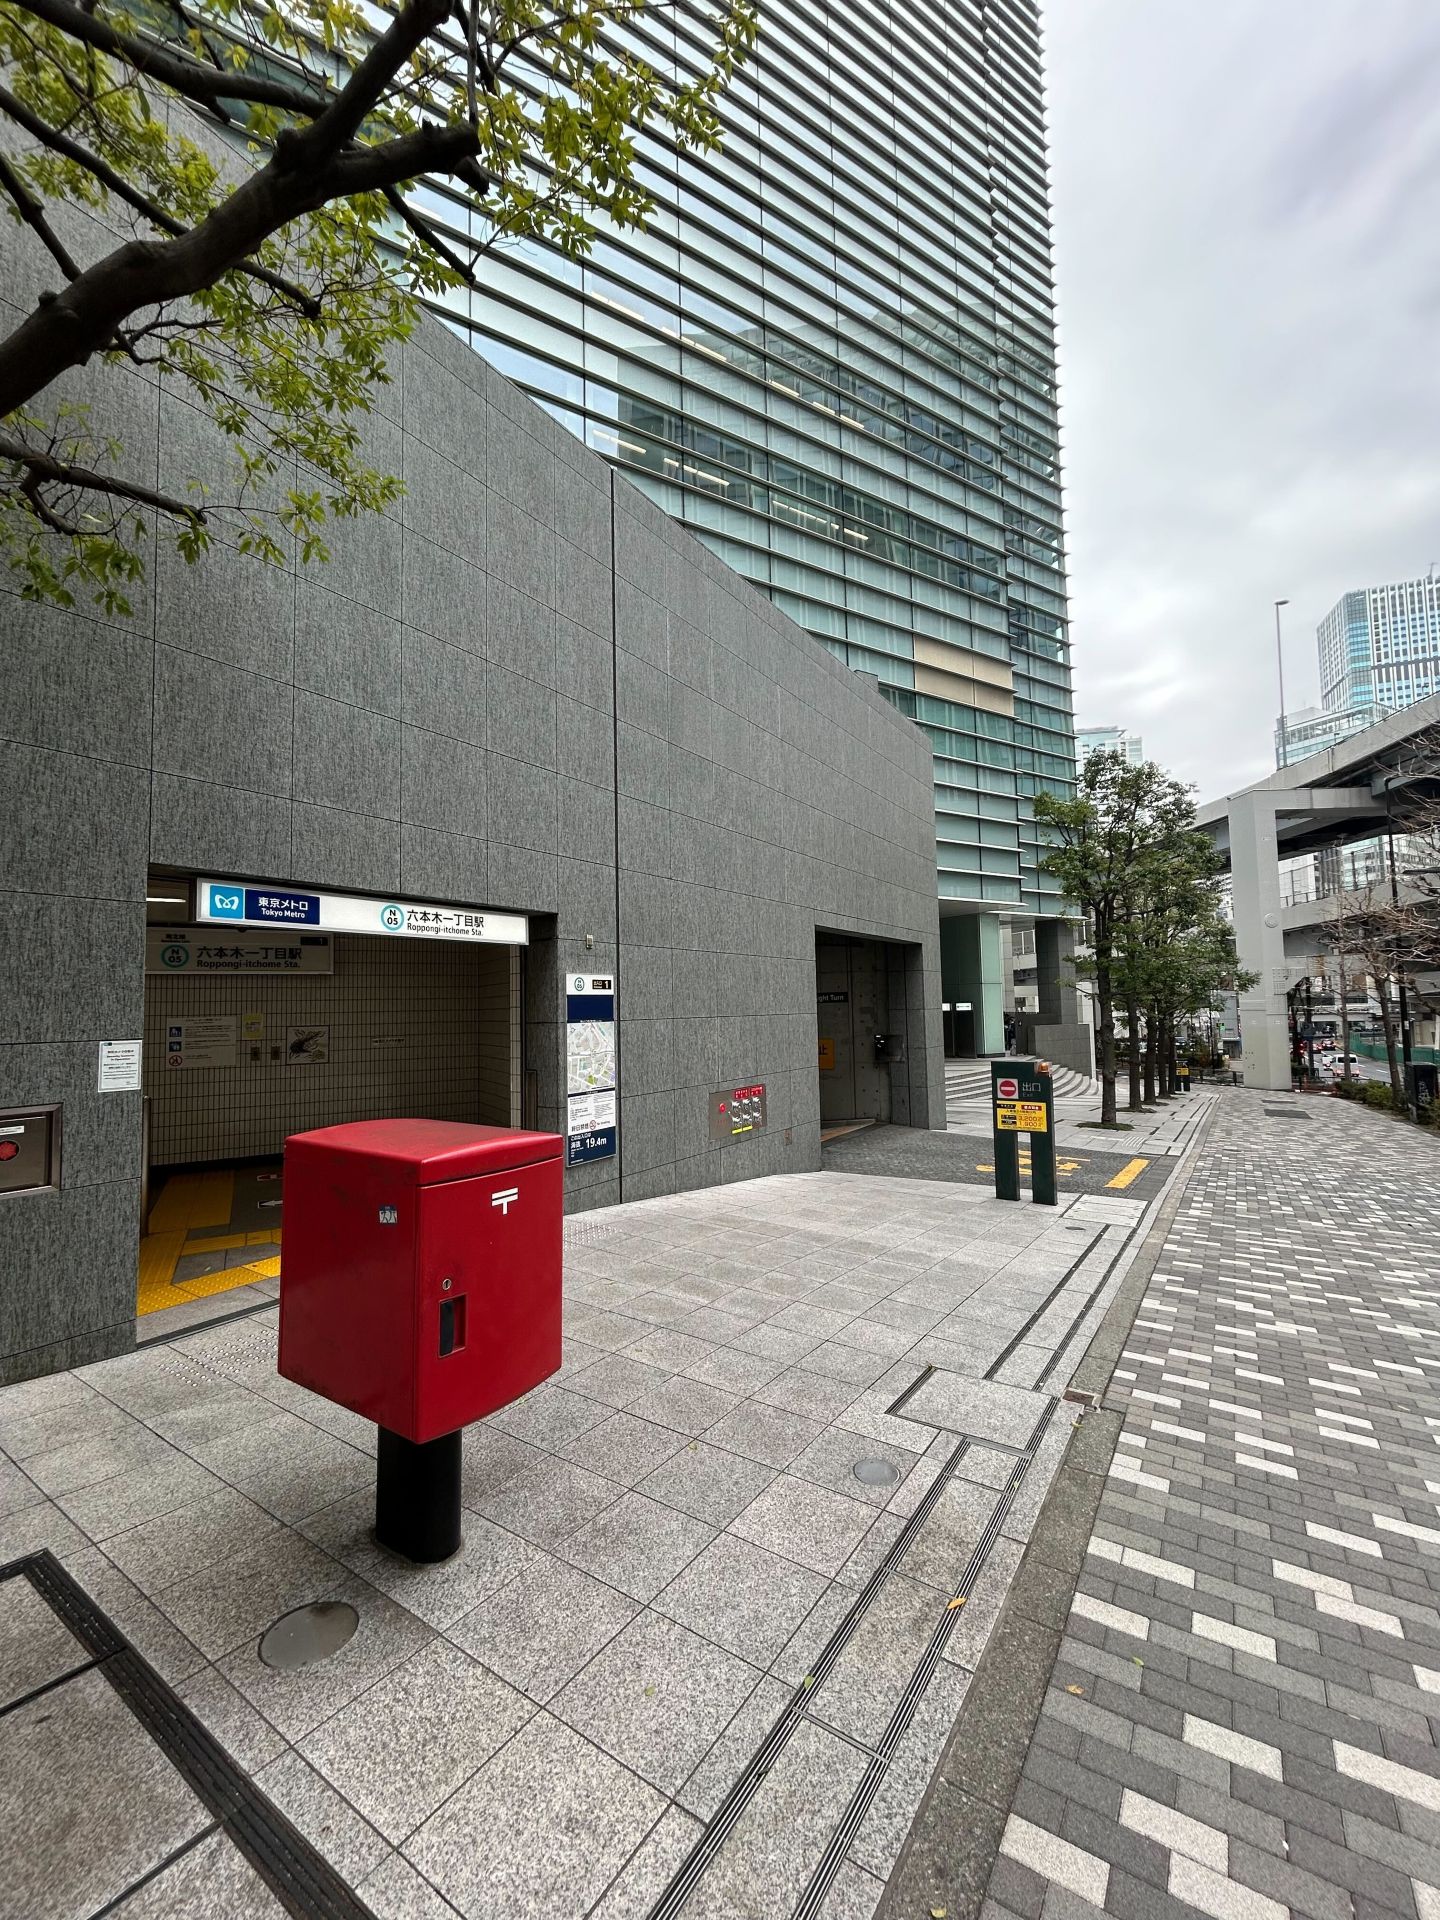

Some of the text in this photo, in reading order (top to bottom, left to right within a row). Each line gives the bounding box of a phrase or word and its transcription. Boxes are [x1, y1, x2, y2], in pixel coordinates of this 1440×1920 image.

[258, 896, 308, 911] 東京メトロ
[261, 907, 306, 919] Tokyo Metro
[387, 917, 398, 925] 05
[407, 910, 484, 927] 六本木一丁目駅
[407, 922, 470, 935] Roppongi-itchome
[197, 946, 302, 960] 六本木一丁目駅
[168, 955, 182, 963] 05
[197, 960, 281, 969] Roppongi-itchome
[604, 980, 609, 989] 1
[818, 994, 829, 1002] ght
[1022, 1082, 1041, 1091] 出口
[585, 1137, 607, 1149] 19.4m
